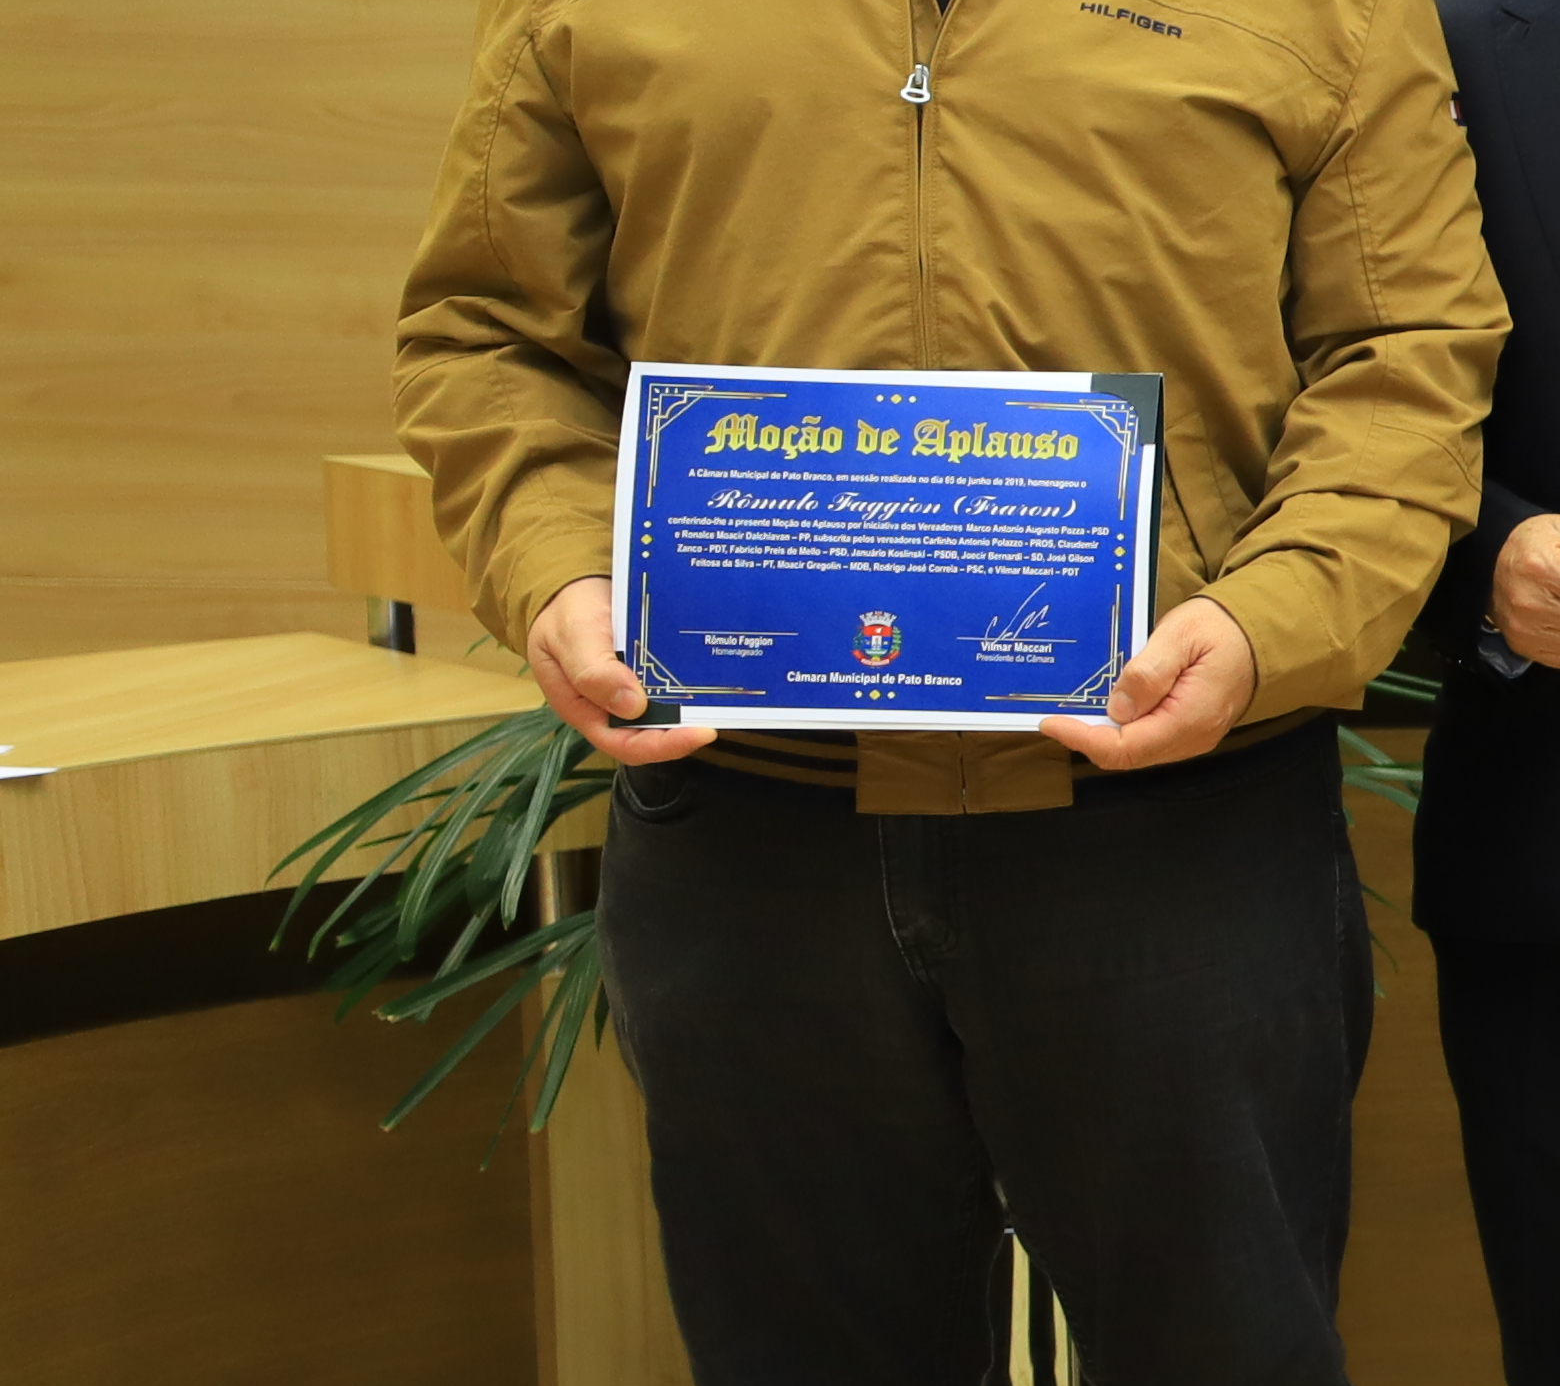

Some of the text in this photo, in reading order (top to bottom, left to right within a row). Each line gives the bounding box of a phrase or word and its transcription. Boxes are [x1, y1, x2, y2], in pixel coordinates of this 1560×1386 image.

[1079, 2, 1183, 39] HILFIGER
[704, 412, 1079, 464] Moção de Aplauso
[980, 641, 1052, 653] Vilmar Maccari
[786, 670, 963, 686] Câmara Municipal de Pato Branco
